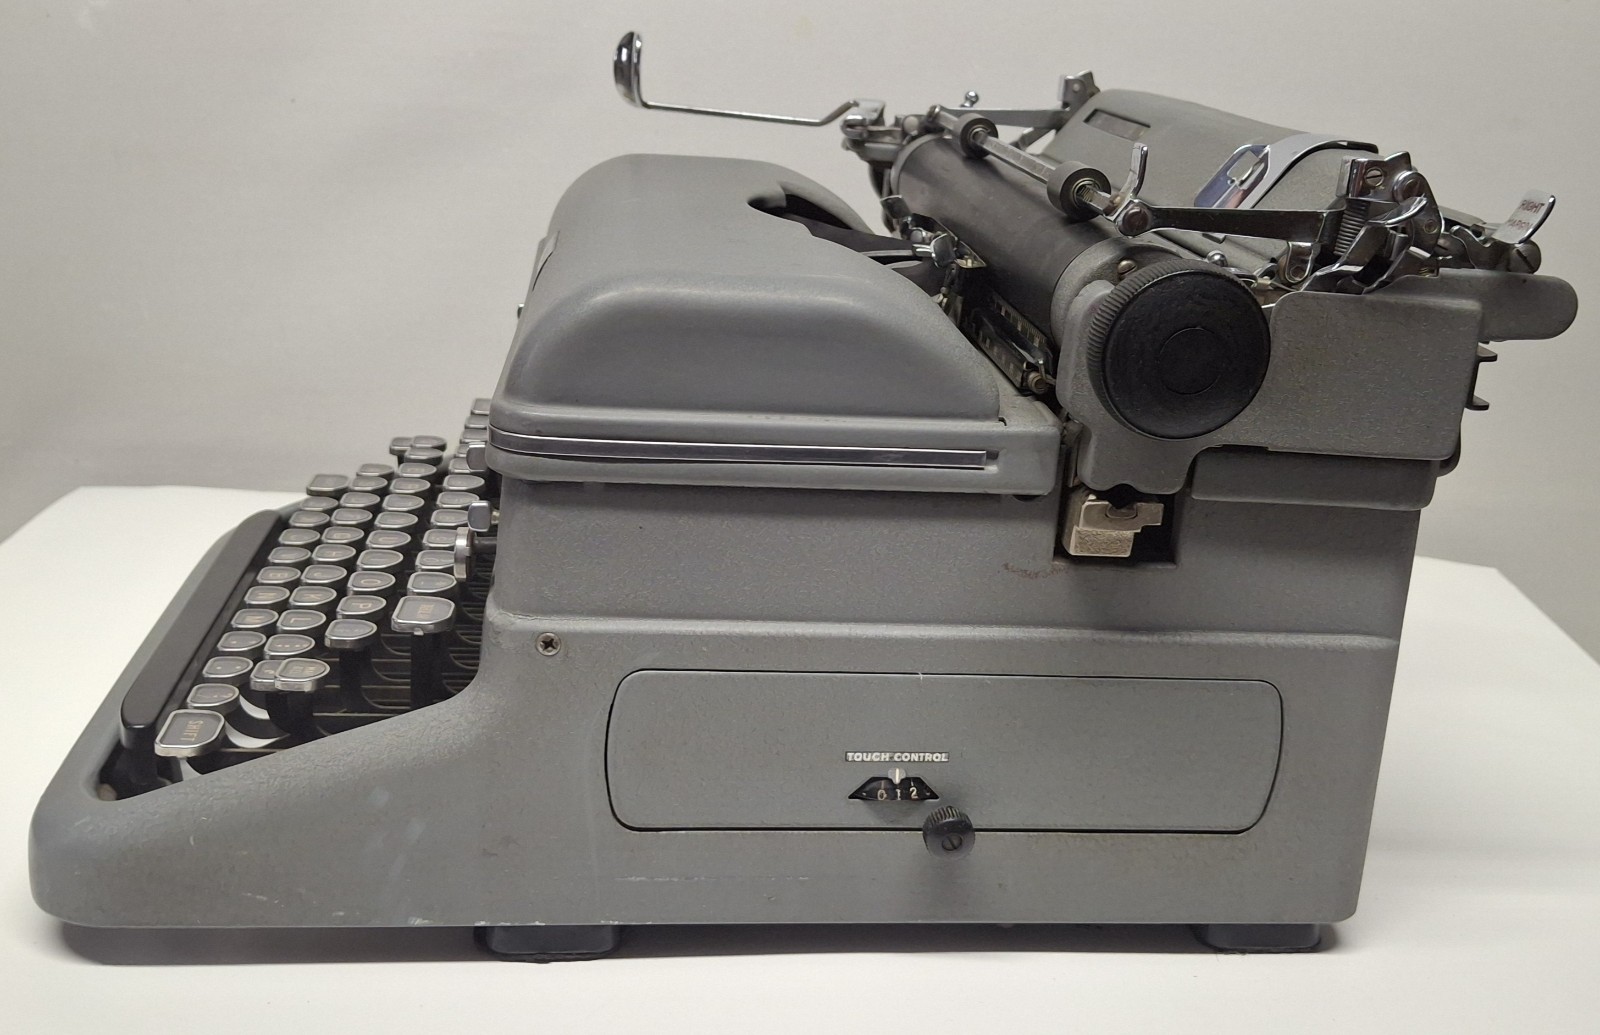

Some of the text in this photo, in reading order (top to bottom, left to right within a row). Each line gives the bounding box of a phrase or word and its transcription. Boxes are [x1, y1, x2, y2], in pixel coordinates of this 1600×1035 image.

[1519, 199, 1545, 213] RIGHT
[180, 720, 204, 742] SHIFT
[847, 752, 949, 762] TOUCH CONTROL
[877, 787, 918, 800] 0 1 2
